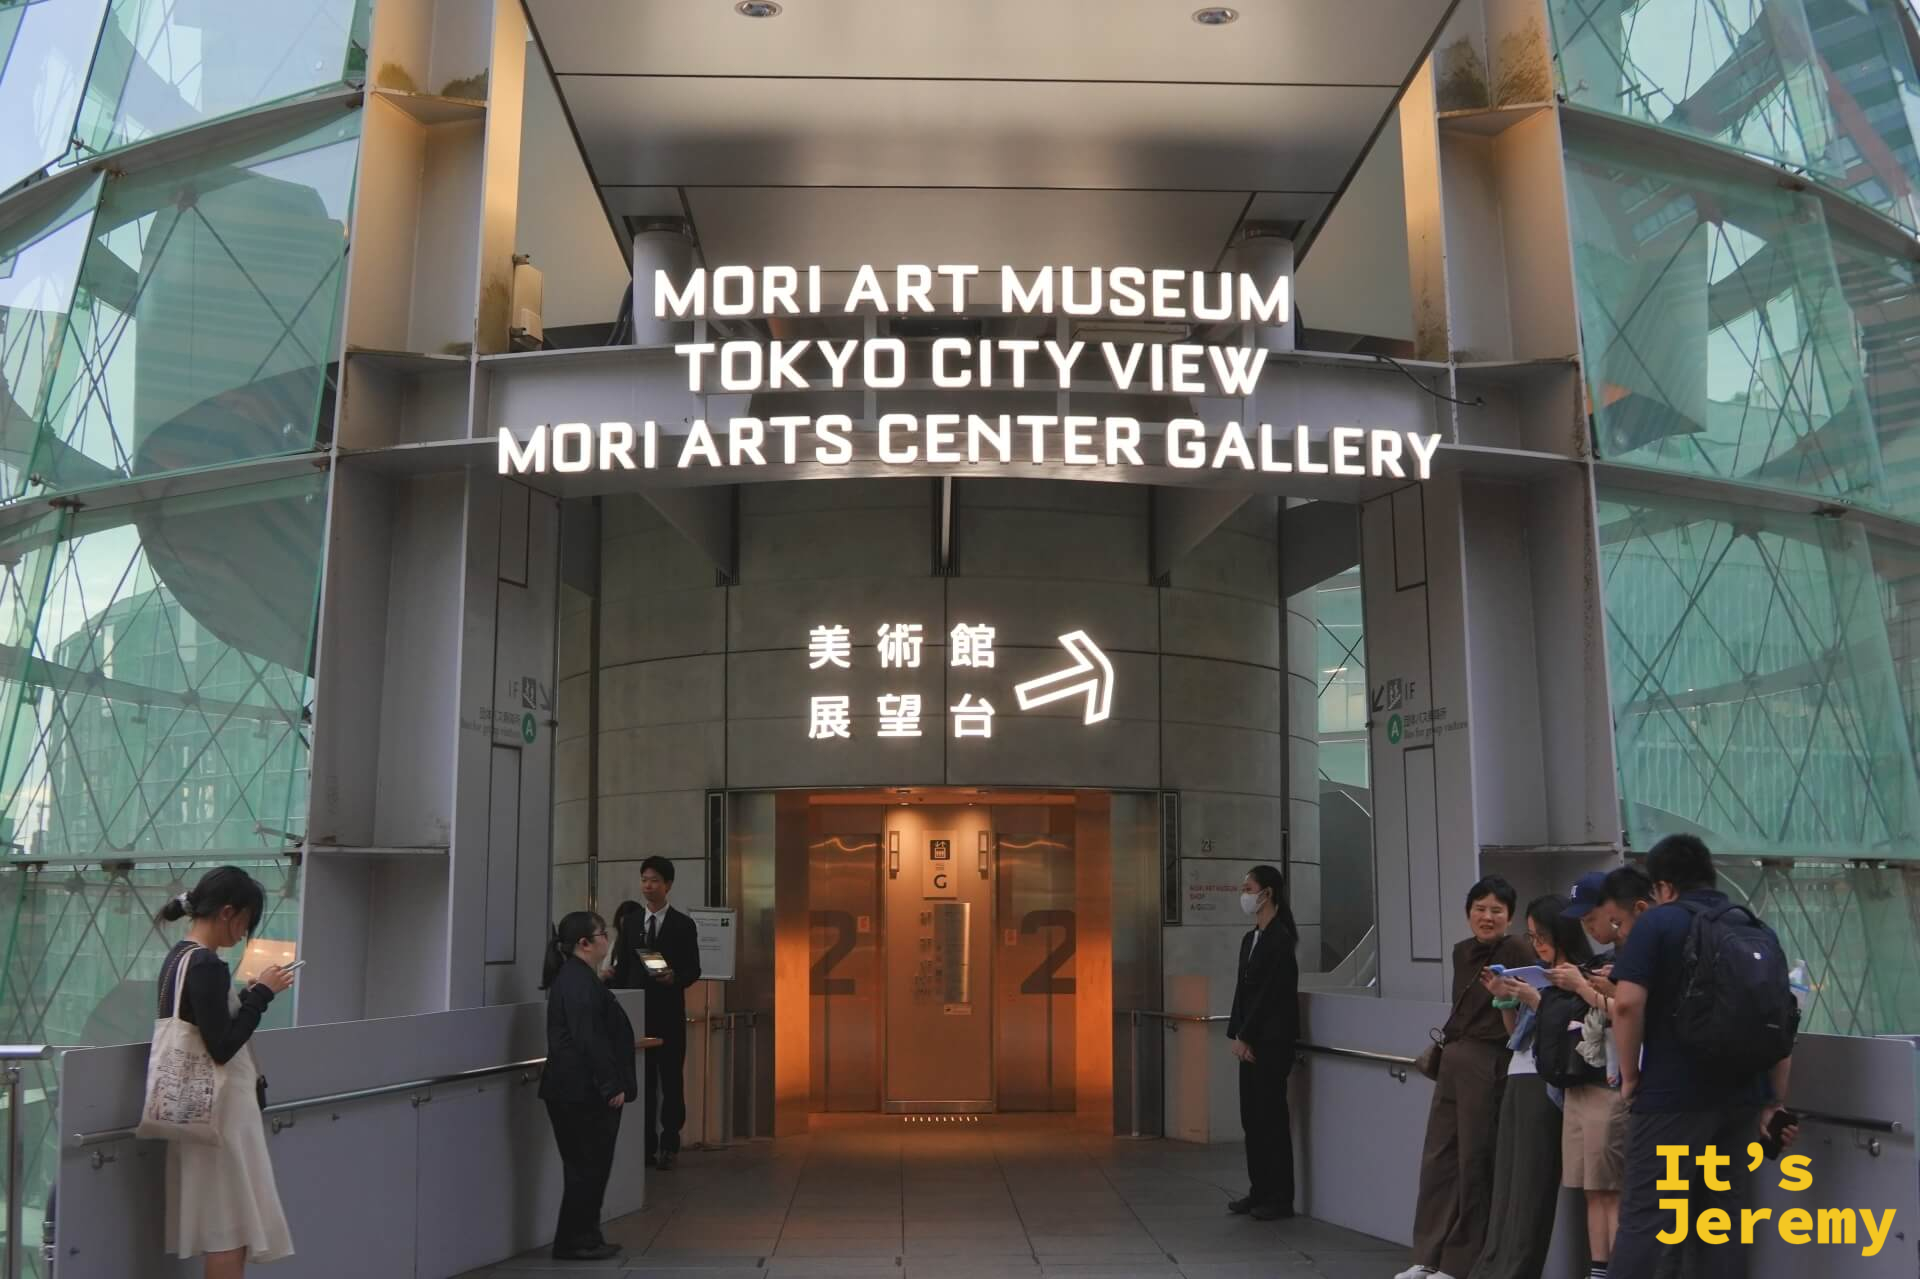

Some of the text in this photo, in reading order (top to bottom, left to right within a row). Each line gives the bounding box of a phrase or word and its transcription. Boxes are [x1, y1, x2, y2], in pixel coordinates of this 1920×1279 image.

[654, 264, 1290, 323] MORI ART MUSEUM
[674, 338, 1268, 396] TOKYO CITY VIEW
[497, 413, 1443, 480] MORI ARTS CENTER GALLERY
[808, 622, 996, 670] 美術館
[808, 692, 996, 740] 展望台
[933, 873, 947, 889] G
[809, 909, 857, 995] 2
[1020, 909, 1077, 995] 2
